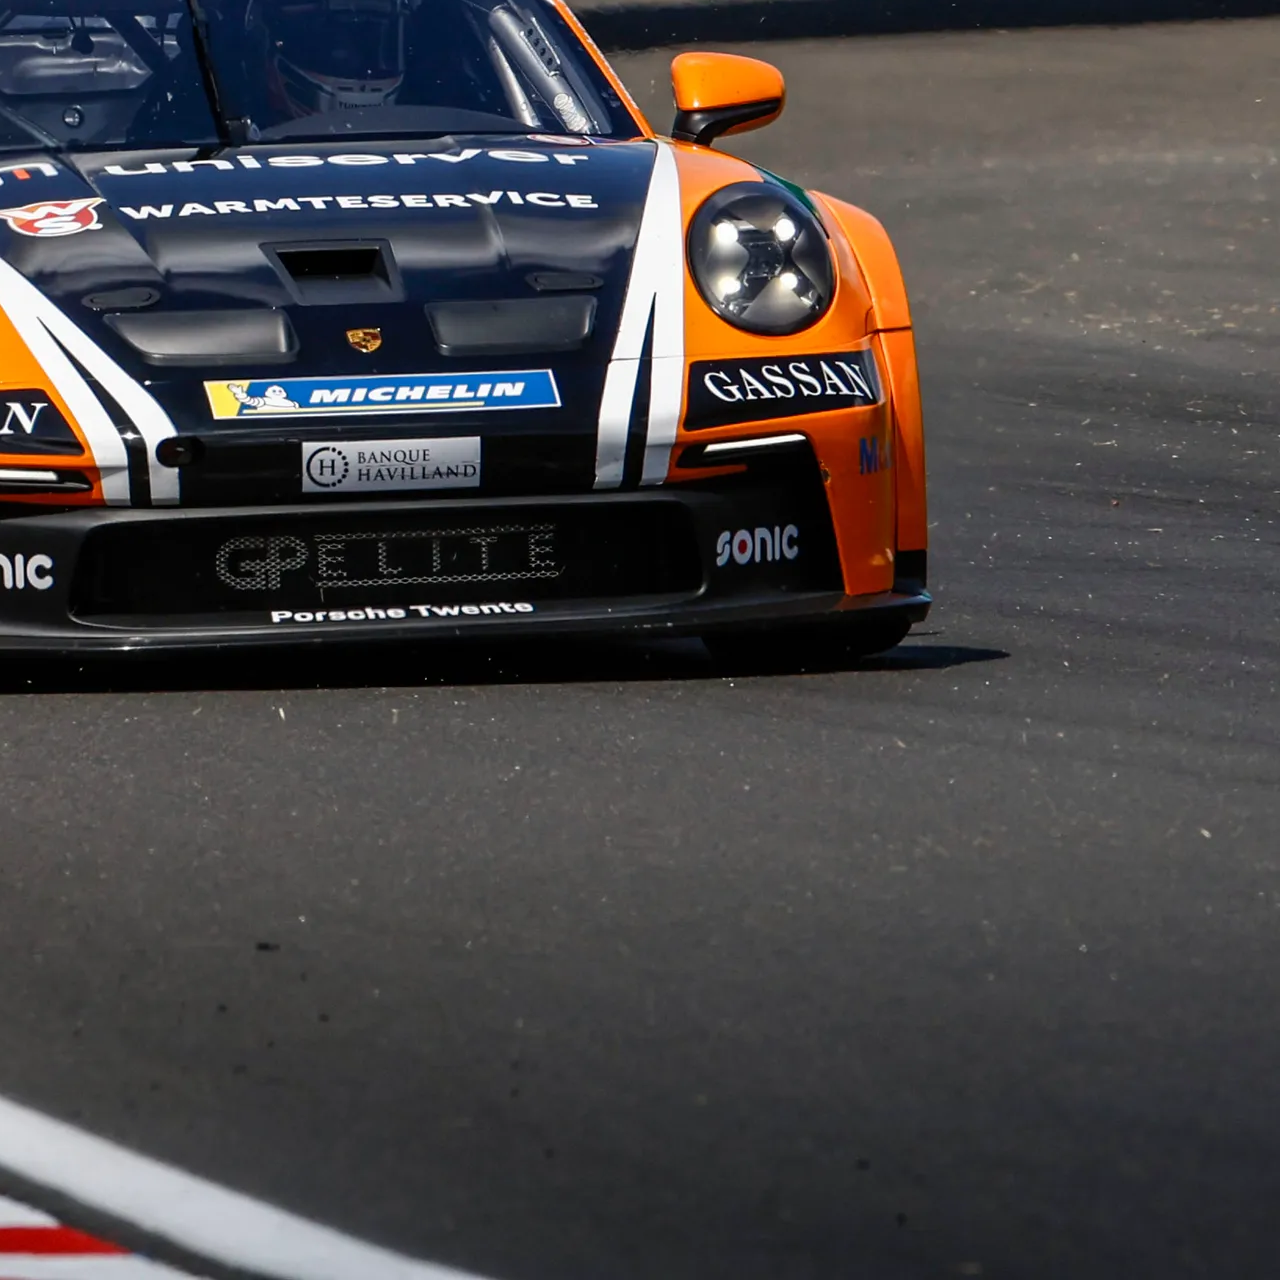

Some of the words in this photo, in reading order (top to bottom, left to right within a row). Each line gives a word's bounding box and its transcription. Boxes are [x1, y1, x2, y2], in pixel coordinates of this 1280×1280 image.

[103, 148, 589, 176] uniserver
[119, 191, 599, 220] WARMTESERVICE
[309, 381, 526, 404] MICHELIN
[703, 361, 875, 402] GASSAN
[356, 449, 431, 464] BANQUE
[356, 463, 478, 483] HAVILLAND
[270, 605, 407, 623] Porsche
[409, 601, 535, 617] Twente
